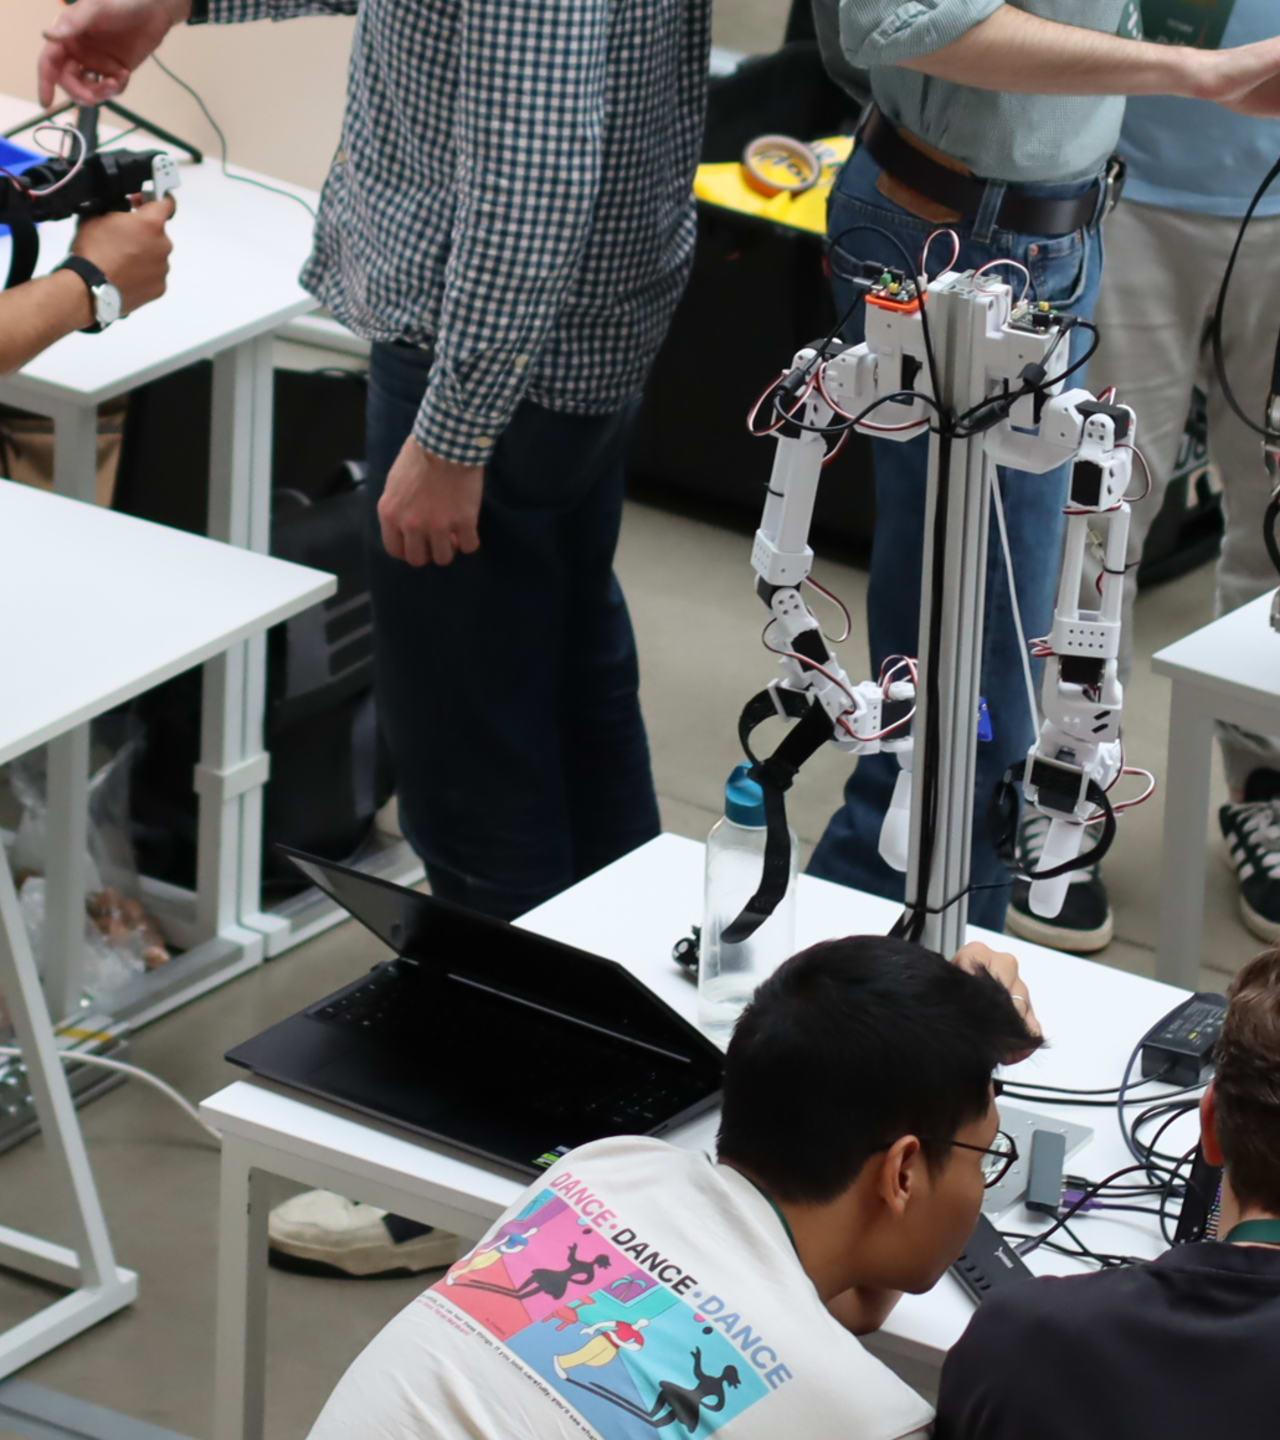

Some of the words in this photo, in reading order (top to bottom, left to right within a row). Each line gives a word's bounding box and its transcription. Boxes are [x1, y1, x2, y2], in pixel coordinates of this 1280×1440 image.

[549, 1171, 617, 1229] DANCE
[611, 1228, 698, 1297] DANCE
[696, 1294, 794, 1391] DANCE
